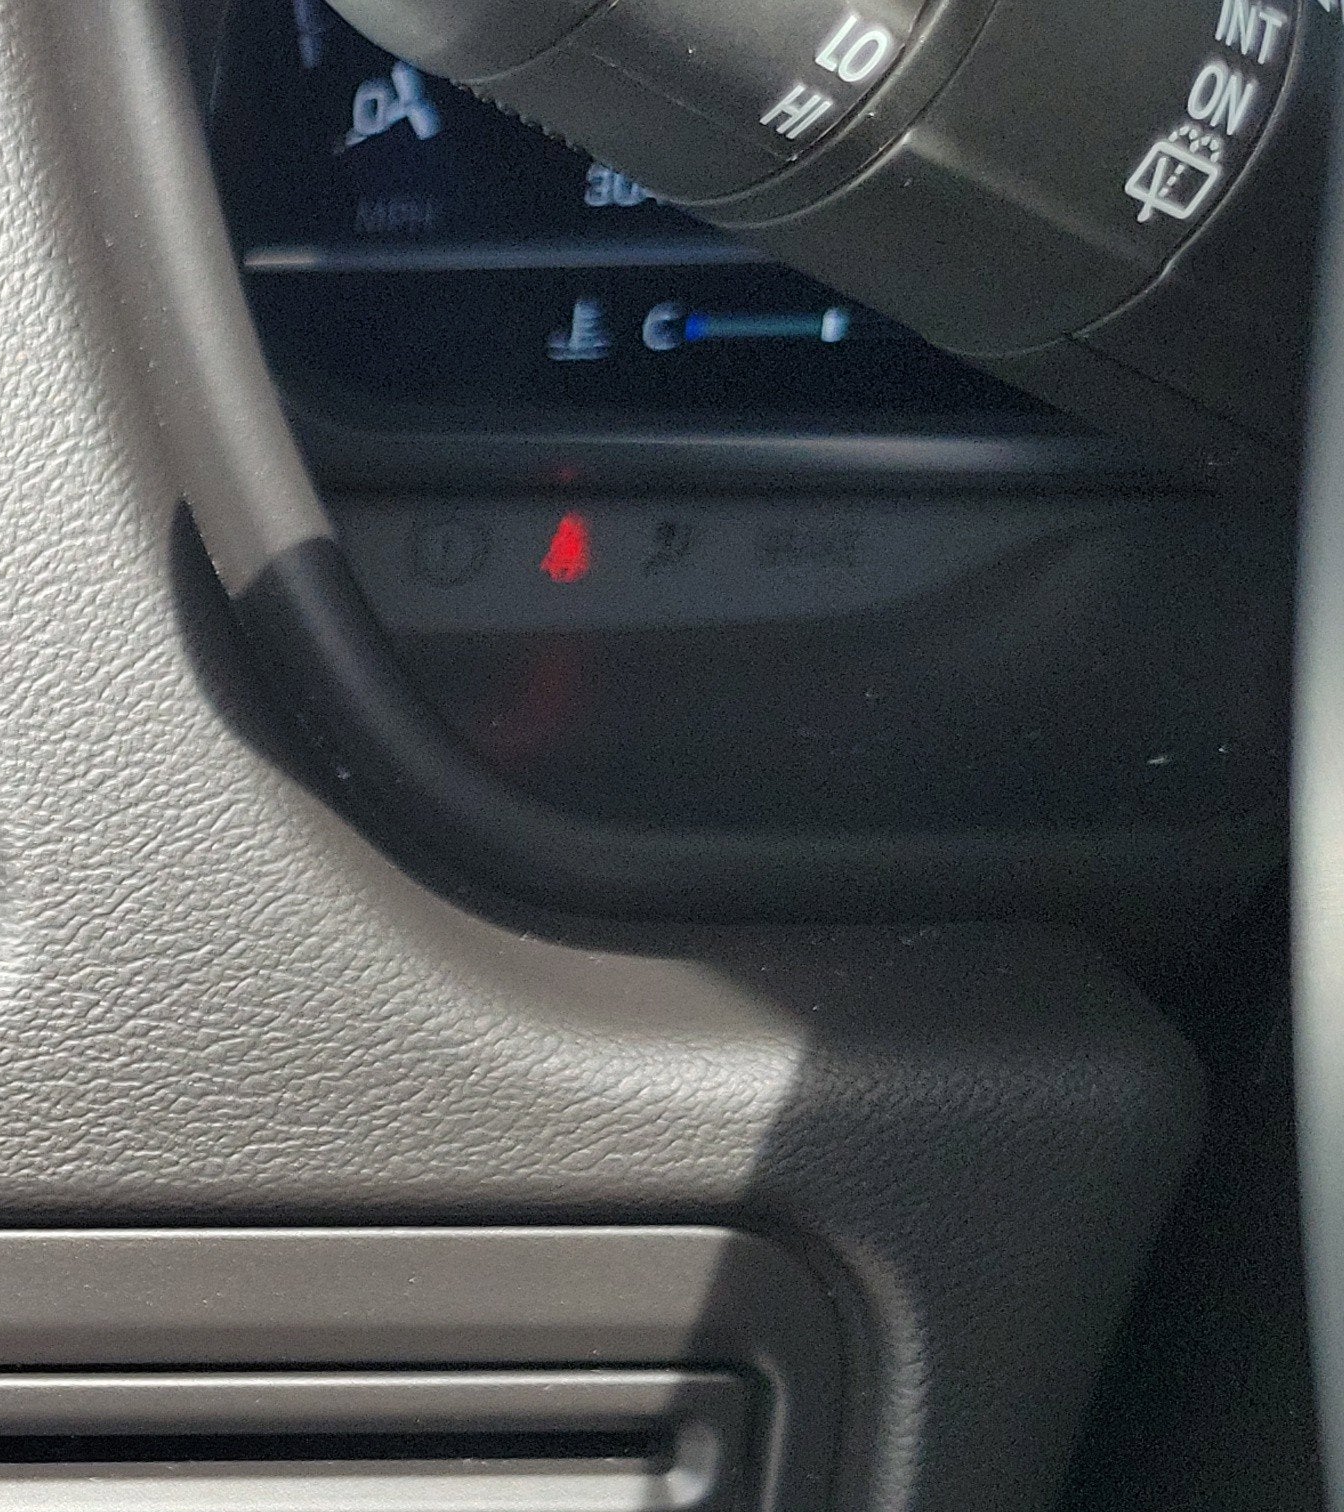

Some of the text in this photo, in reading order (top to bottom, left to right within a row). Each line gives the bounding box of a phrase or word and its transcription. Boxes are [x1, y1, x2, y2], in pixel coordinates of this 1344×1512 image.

[815, 14, 889, 82] LO
[759, 82, 833, 139] HI
[1187, 63, 1255, 135] ON
